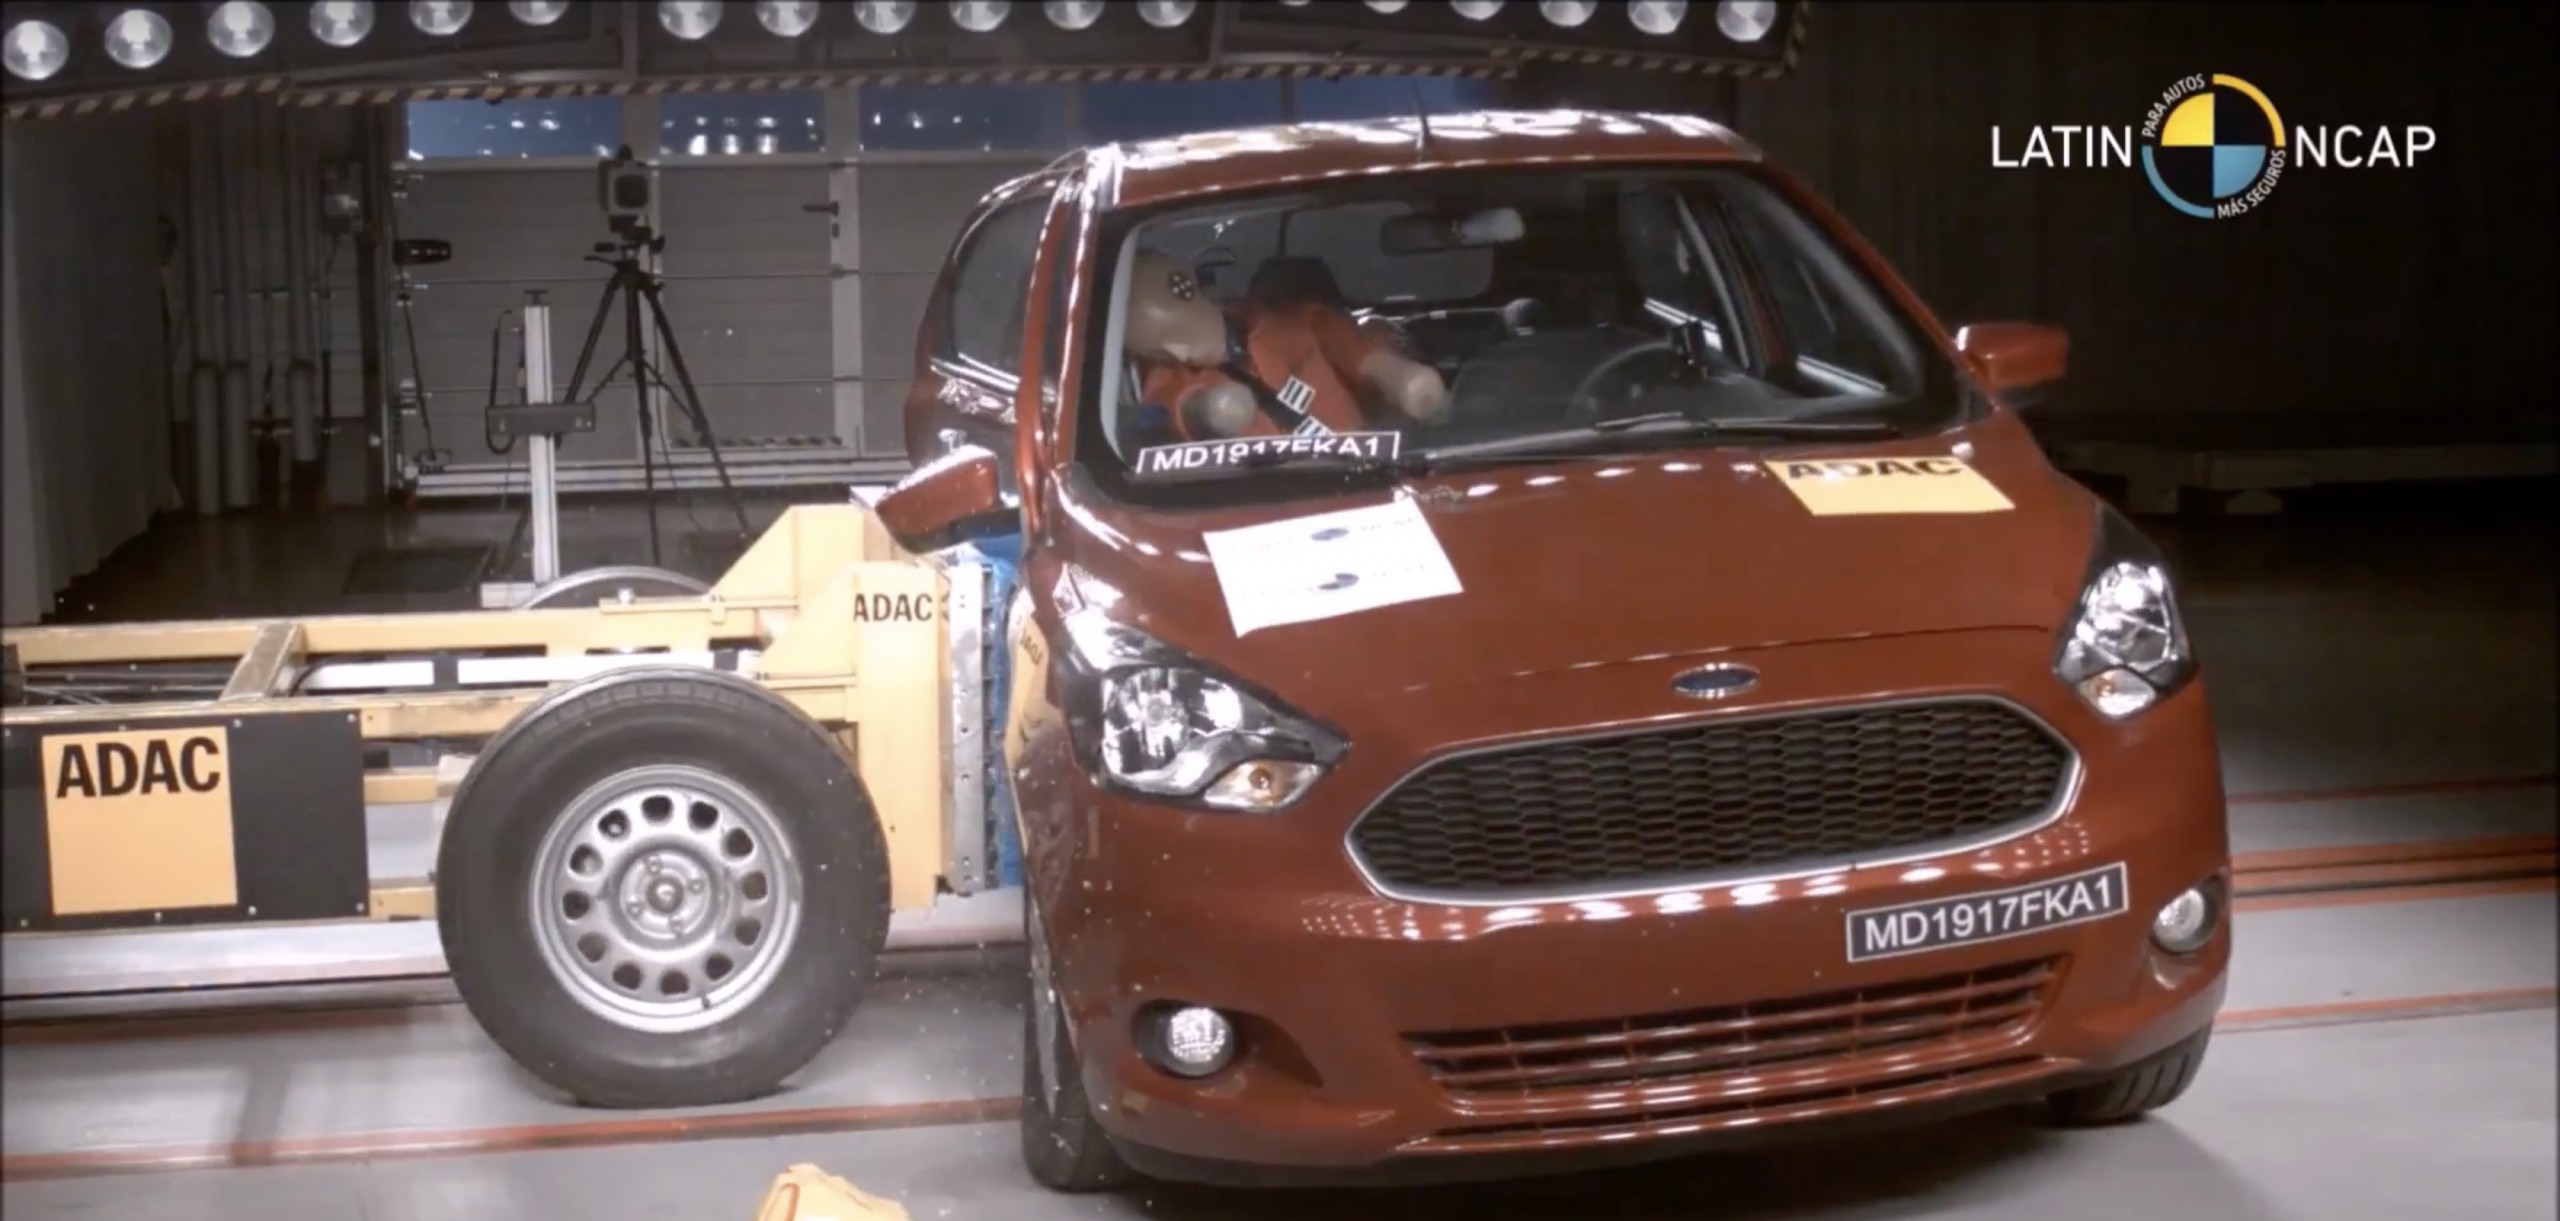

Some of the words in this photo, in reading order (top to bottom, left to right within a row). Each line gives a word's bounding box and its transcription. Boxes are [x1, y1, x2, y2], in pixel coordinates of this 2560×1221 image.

[853, 592, 933, 623] ADAC
[56, 736, 221, 799] ADAC
[1864, 874, 2112, 952] MD1917FKA1
